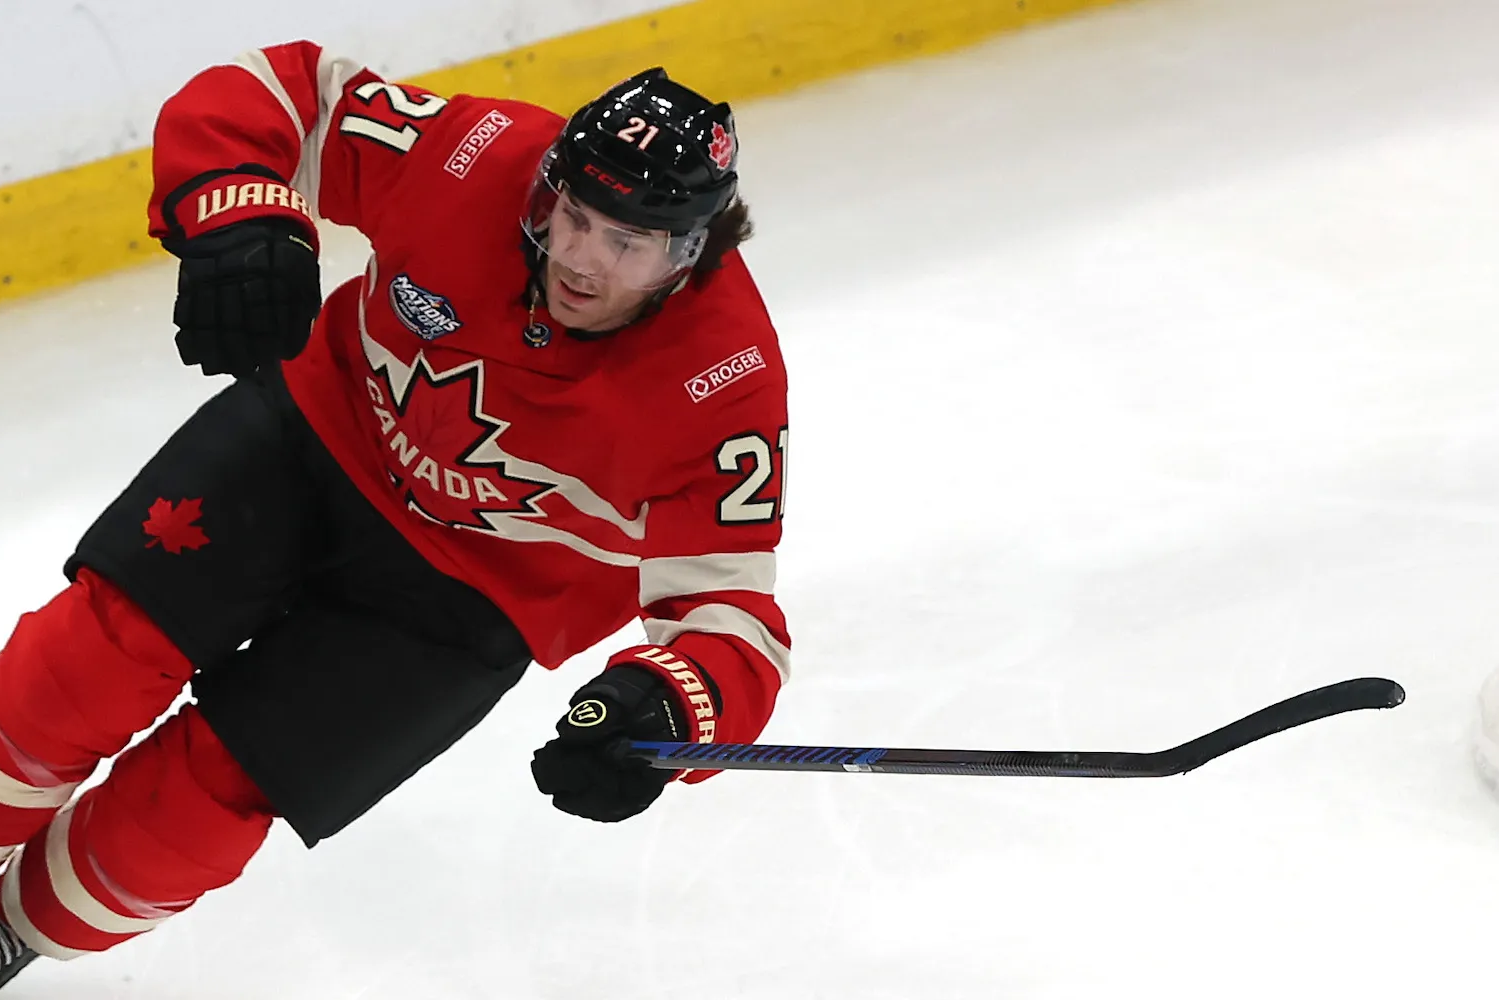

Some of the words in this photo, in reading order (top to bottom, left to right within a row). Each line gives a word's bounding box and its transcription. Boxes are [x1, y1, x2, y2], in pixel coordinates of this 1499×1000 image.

[339, 81, 449, 154] 21
[617, 117, 660, 150] 21
[450, 119, 499, 172] ROGERS
[583, 163, 633, 195] CCM
[396, 275, 462, 333] NATIONS
[708, 349, 764, 387] ROGERS
[366, 376, 508, 503] CANADA
